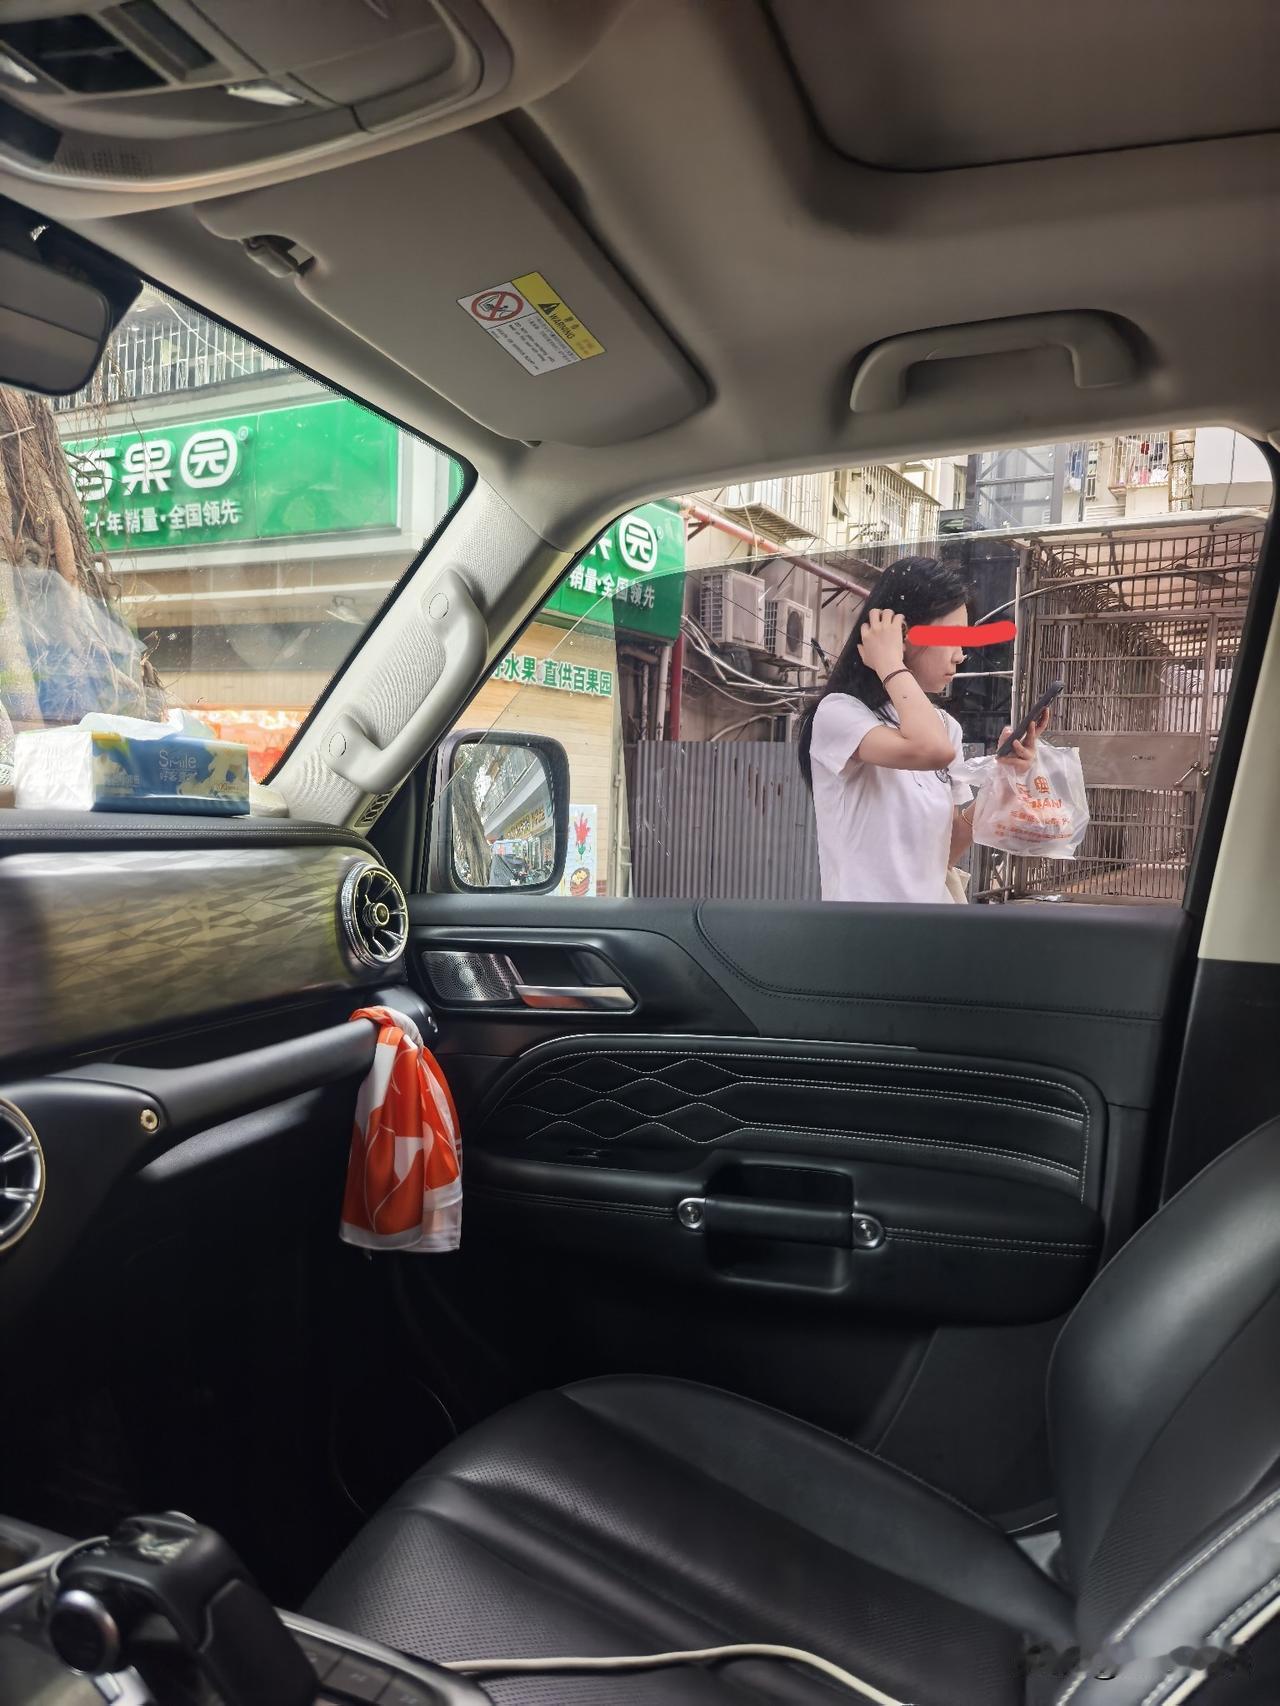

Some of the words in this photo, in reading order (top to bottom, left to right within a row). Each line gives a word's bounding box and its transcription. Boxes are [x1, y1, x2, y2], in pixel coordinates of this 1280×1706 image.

[550, 314, 575, 340] WARNING
[544, 660, 612, 695] 直供百果园
